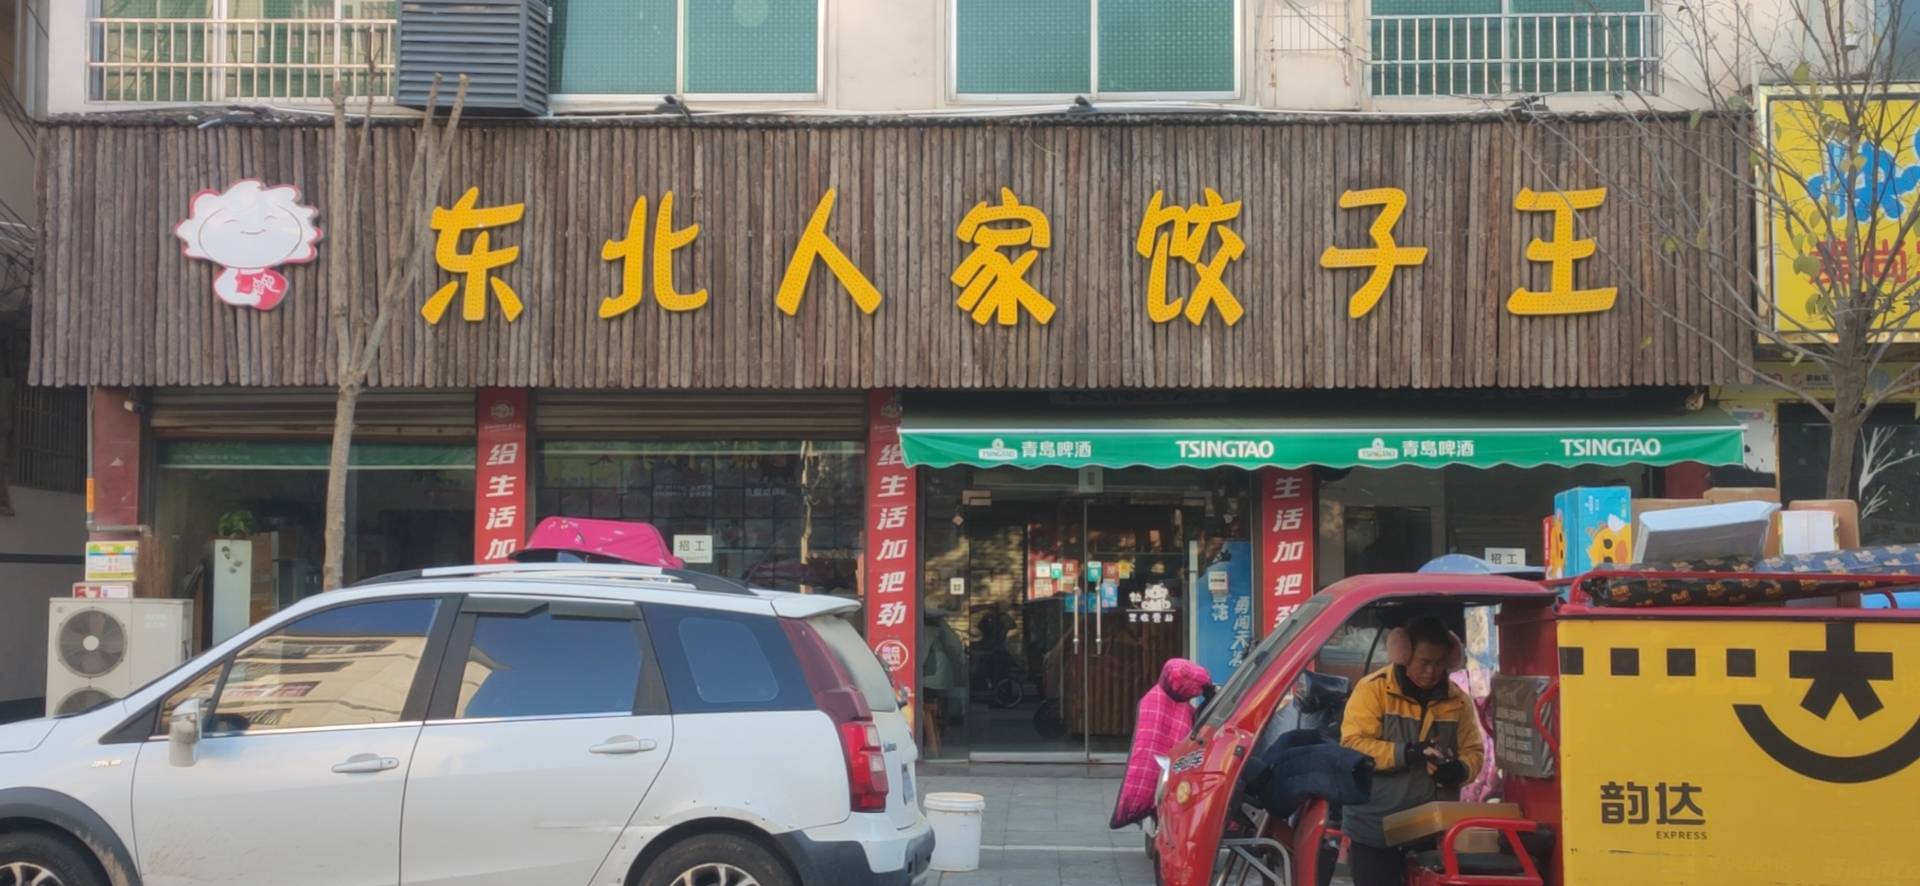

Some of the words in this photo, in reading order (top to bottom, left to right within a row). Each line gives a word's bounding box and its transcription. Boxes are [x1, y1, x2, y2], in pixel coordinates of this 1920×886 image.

[421, 186, 1618, 326] 东北人家饺子王
[1021, 441, 1092, 458] 青岛啤酒
[1177, 440, 1275, 459] TSINGTAO
[1402, 440, 1474, 457] 青岛啤酒
[1561, 438, 1661, 457] TSINGTAO
[876, 443, 909, 627] 给生活加把劲
[679, 540, 705, 551] 招工
[1491, 552, 1518, 565] 招工
[1600, 781, 1706, 826] 韵达
[1656, 831, 1708, 840] EXPRESS
